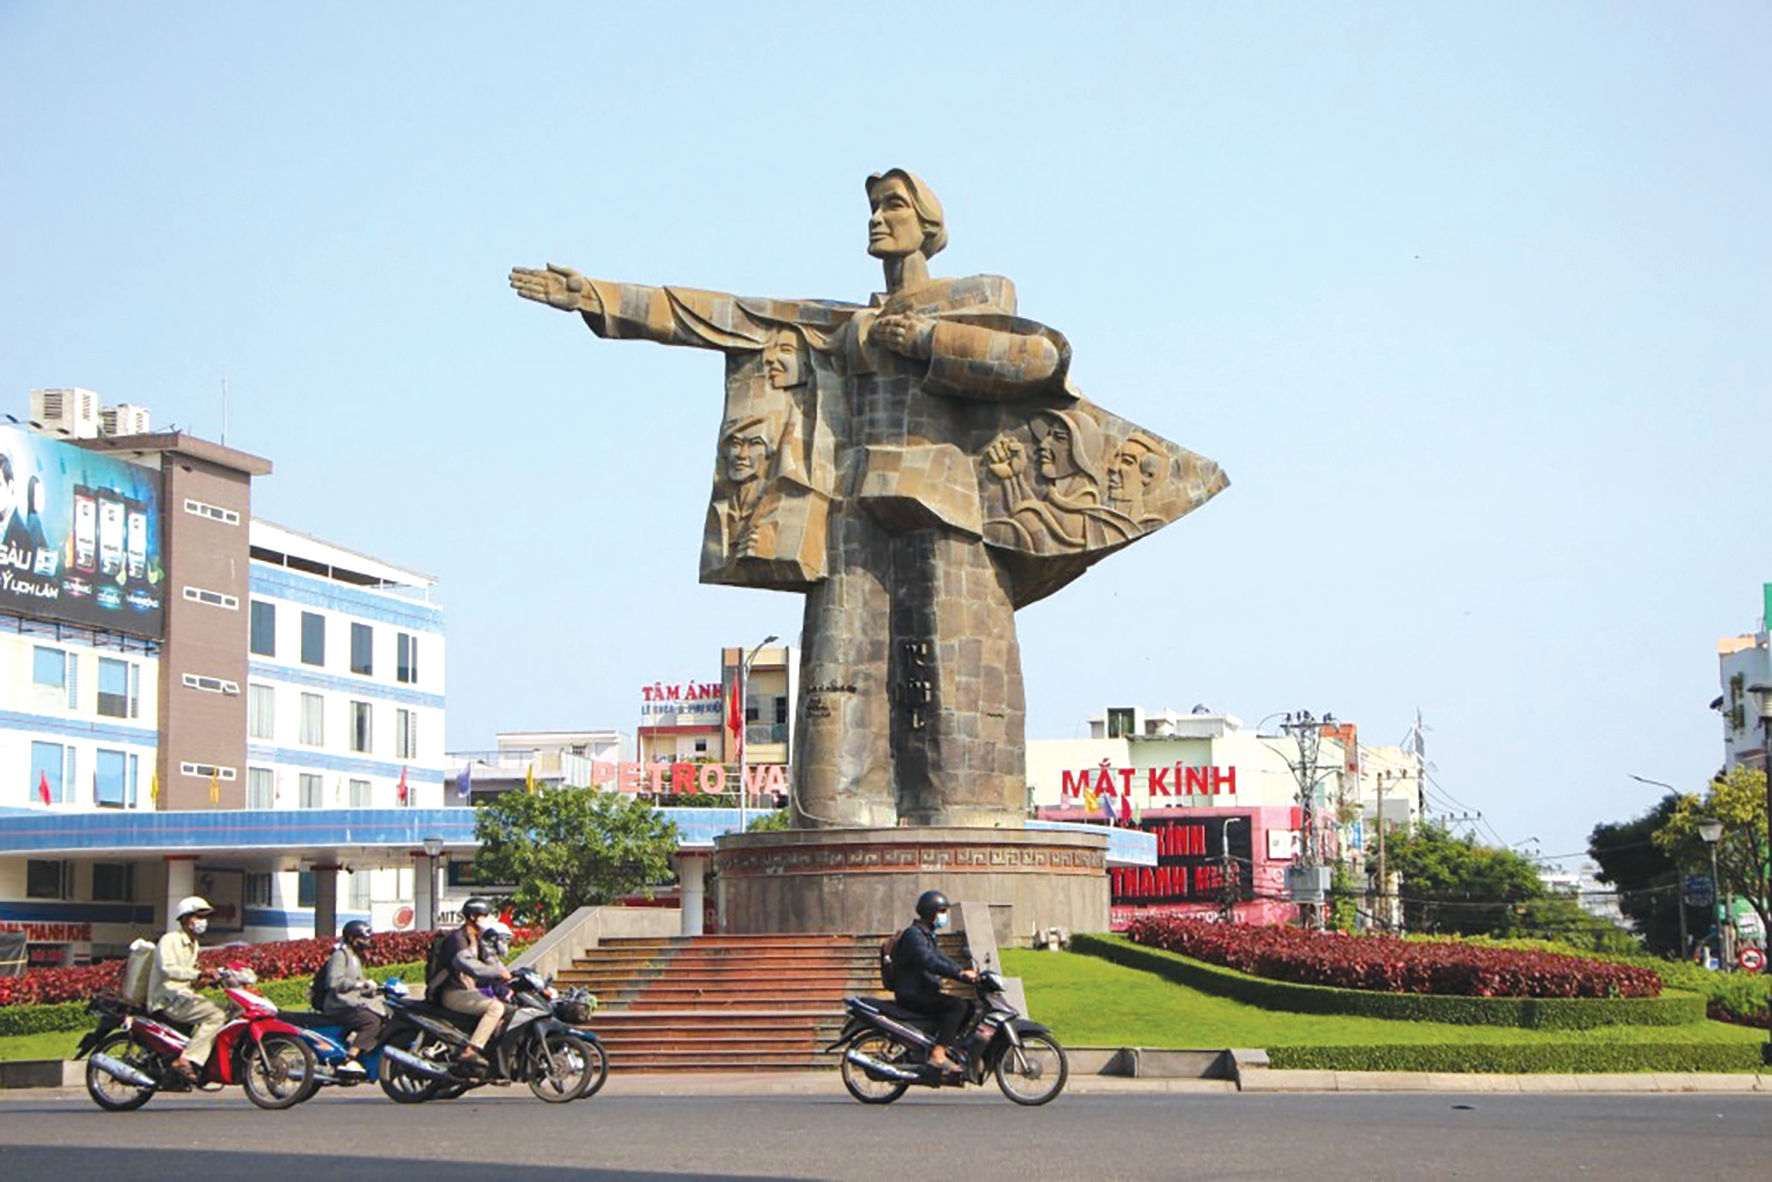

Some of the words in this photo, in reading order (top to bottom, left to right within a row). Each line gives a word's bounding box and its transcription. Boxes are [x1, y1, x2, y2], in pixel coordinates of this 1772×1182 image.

[642, 681, 680, 701] TÂM
[591, 761, 727, 795] PETRO
[1061, 757, 1136, 798] MẮT
[1150, 760, 1236, 796] KÍNH
[1111, 866, 1187, 896] THANH
